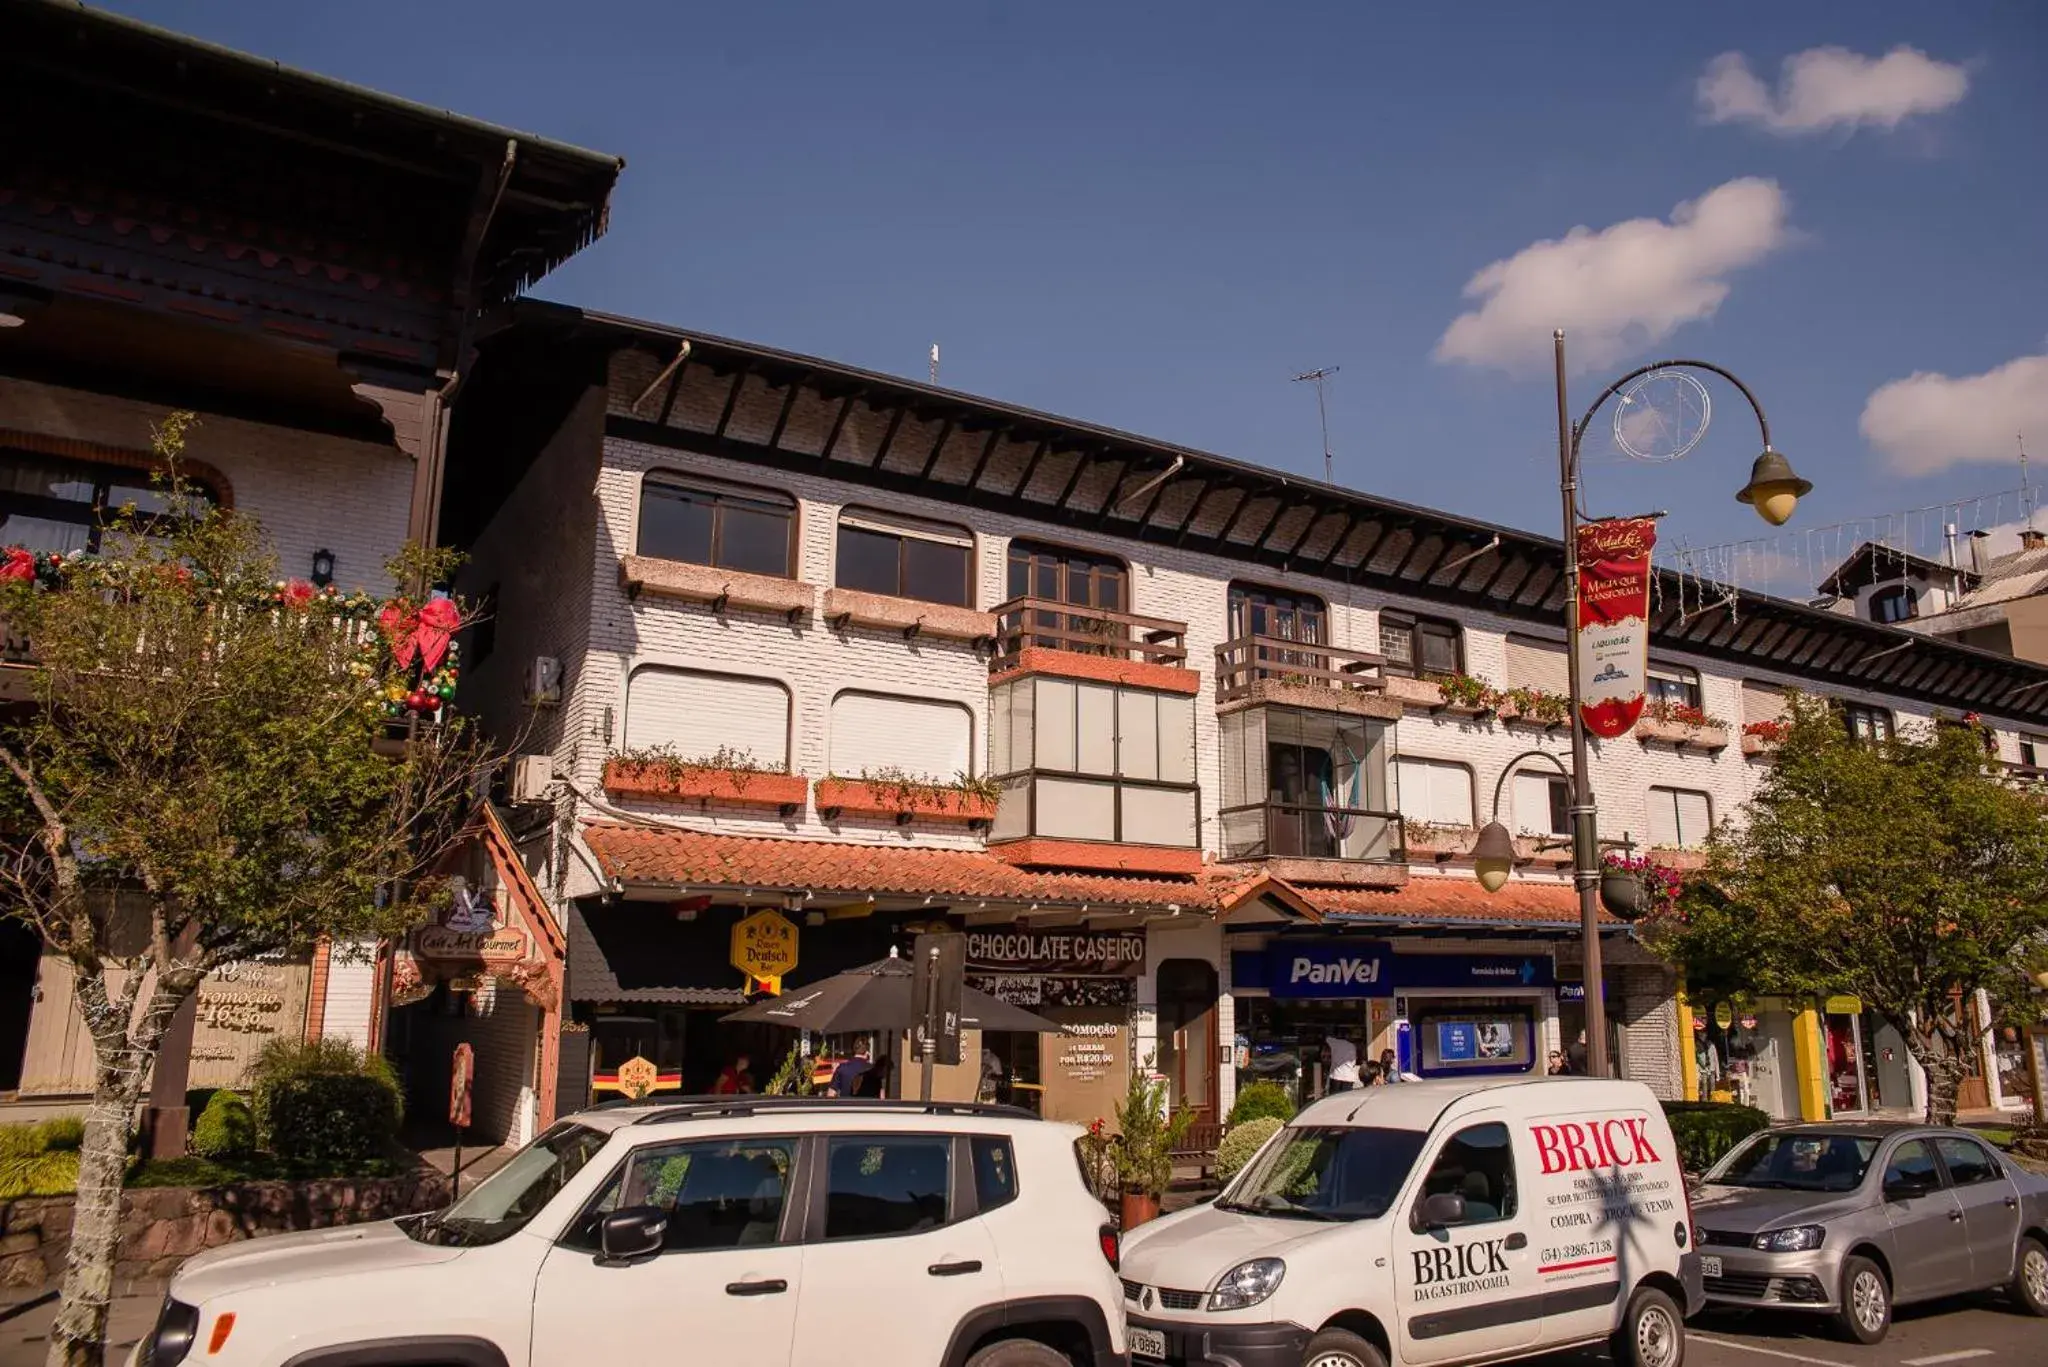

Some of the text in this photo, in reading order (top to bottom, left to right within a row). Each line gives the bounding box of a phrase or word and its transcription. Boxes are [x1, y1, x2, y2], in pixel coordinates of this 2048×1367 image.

[1619, 575, 1639, 587] QUE
[746, 947, 788, 962] Deutsch
[968, 934, 1143, 961] CHOCOLATE CASEIRO
[1290, 958, 1380, 985] PanVel
[1529, 1118, 1661, 1174] BRICK
[1550, 1200, 1673, 1229] COMPRA TROCA VENDA
[1411, 1238, 1509, 1285] BRICK
[1541, 1247, 1562, 1264] (54)
[1430, 1275, 1510, 1300] GASTRONOMIA
